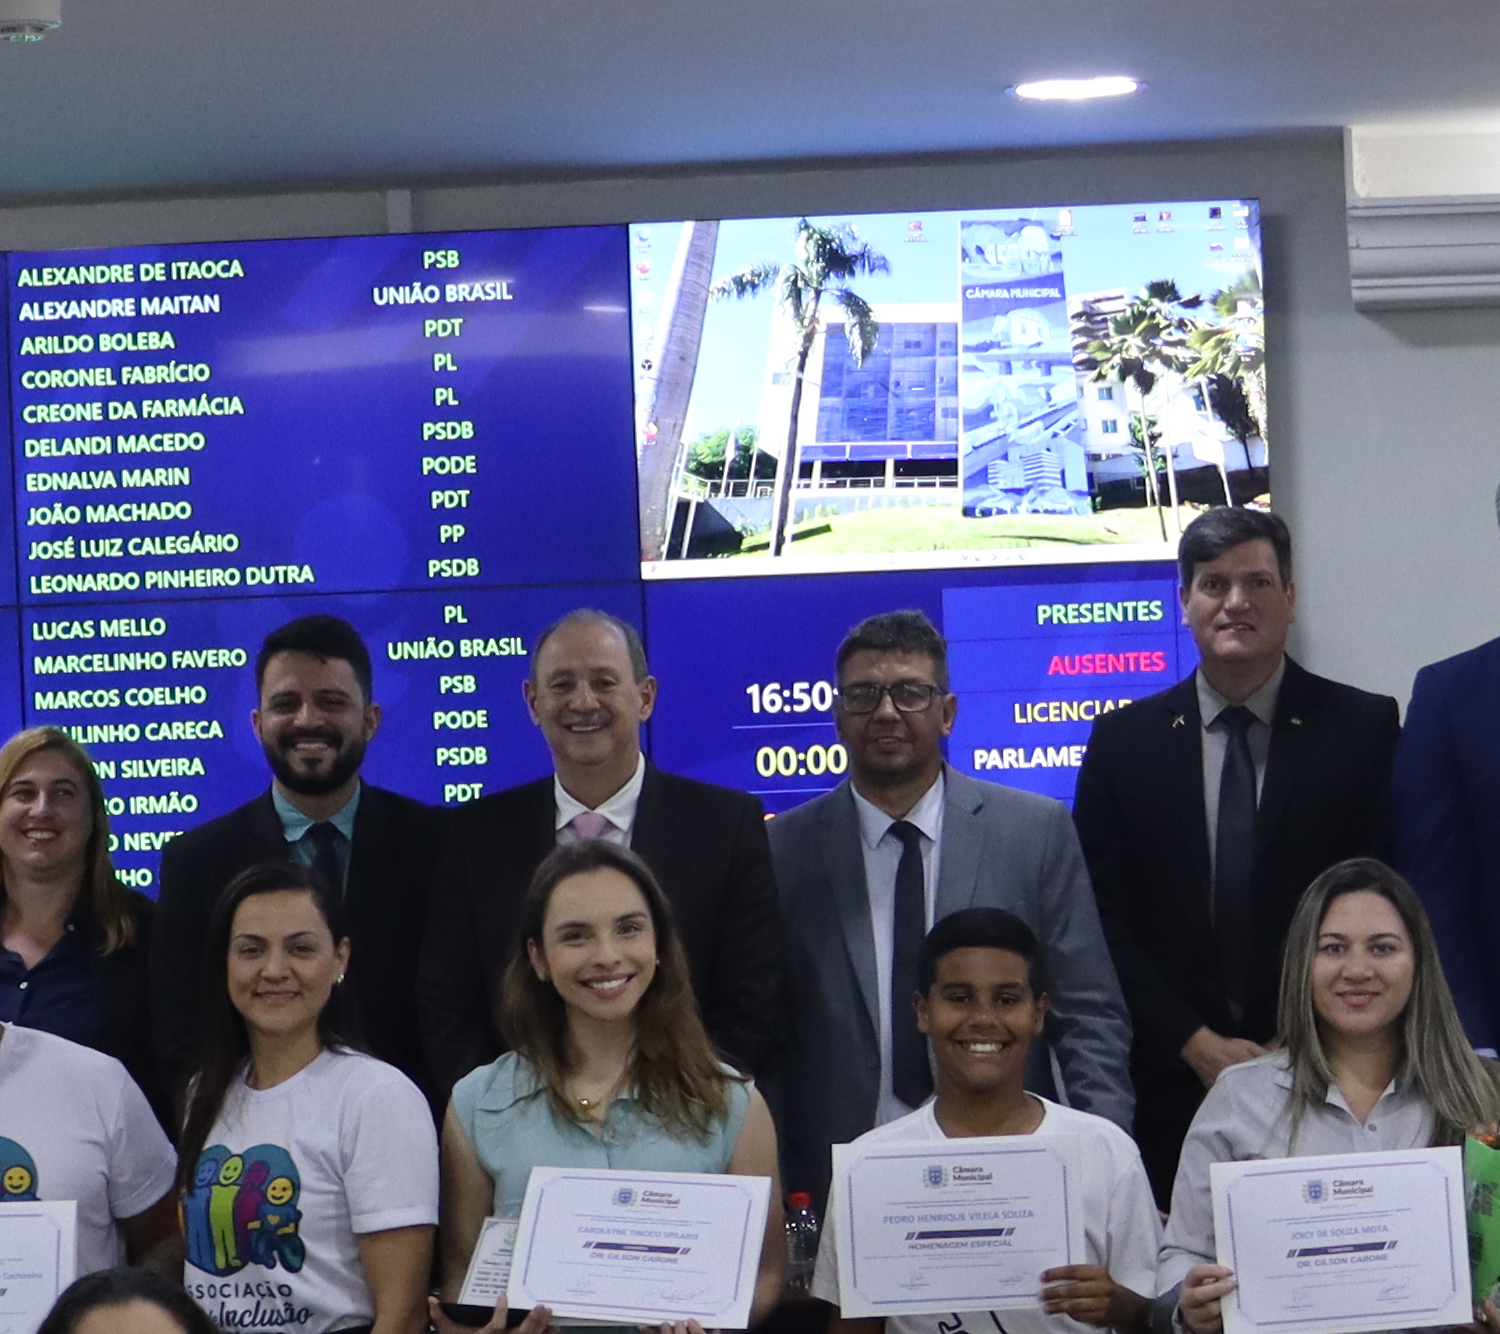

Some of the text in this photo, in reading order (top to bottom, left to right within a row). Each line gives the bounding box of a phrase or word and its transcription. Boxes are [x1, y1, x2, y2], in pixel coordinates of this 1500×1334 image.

[424, 250, 459, 268] PSB
[18, 260, 244, 287] ALEXANDRE DE ITAOCA
[374, 280, 513, 305] UNIÃO BRASIL
[965, 286, 1062, 299] CÂMARA MUNICIPAL
[19, 295, 220, 321] ALEXANDRE MAITAN
[425, 318, 463, 337] PDT
[21, 331, 175, 355] ARILDO BOLEBA
[434, 353, 457, 371] PL
[22, 360, 210, 389] CORONEL FABRÍCIO
[23, 393, 244, 423] CREONE DA FARMÁCIA
[435, 387, 458, 406] PL
[423, 421, 474, 440] PSDB
[25, 432, 205, 457] DELANDI MACEDO
[423, 455, 476, 475] PODE
[27, 467, 189, 491] EDNALVA MARIN
[432, 490, 470, 508] PDT
[27, 501, 191, 525] JOÃO MACHADO
[29, 531, 238, 560] JOSÉ LUIZ CALEGÁRIO
[440, 525, 465, 543] PP
[429, 558, 479, 577] PSDB
[31, 565, 314, 594] LEONARDO PINHEIRO DUTRA
[445, 605, 467, 623] PL
[1038, 600, 1163, 625] PRESENTES
[33, 618, 166, 640] LUCAS MELLO
[388, 637, 527, 660] UNIÃO BRASIL
[34, 648, 246, 674] MARCELINHO FAVERO
[1048, 652, 1166, 675] AUSENTES
[440, 675, 476, 694] PSB
[35, 686, 206, 710] MARCOS COELHO
[434, 710, 488, 729] PODE
[62, 720, 223, 743] ULINHO CARECA
[437, 747, 487, 765] PSDB
[757, 744, 847, 777] 00:00
[974, 746, 1087, 770] PARLAME
[121, 758, 204, 778] SILVEIRA
[130, 791, 197, 814] IRMÃO
[445, 783, 483, 802] PDT
[124, 831, 183, 851] NEV
[883, 1215, 915, 1224] PEDRO
[917, 1213, 966, 1223] HENRIQUE
[1001, 1210, 1034, 1219] SOUZA
[219, 1299, 315, 1328] Inclusão
